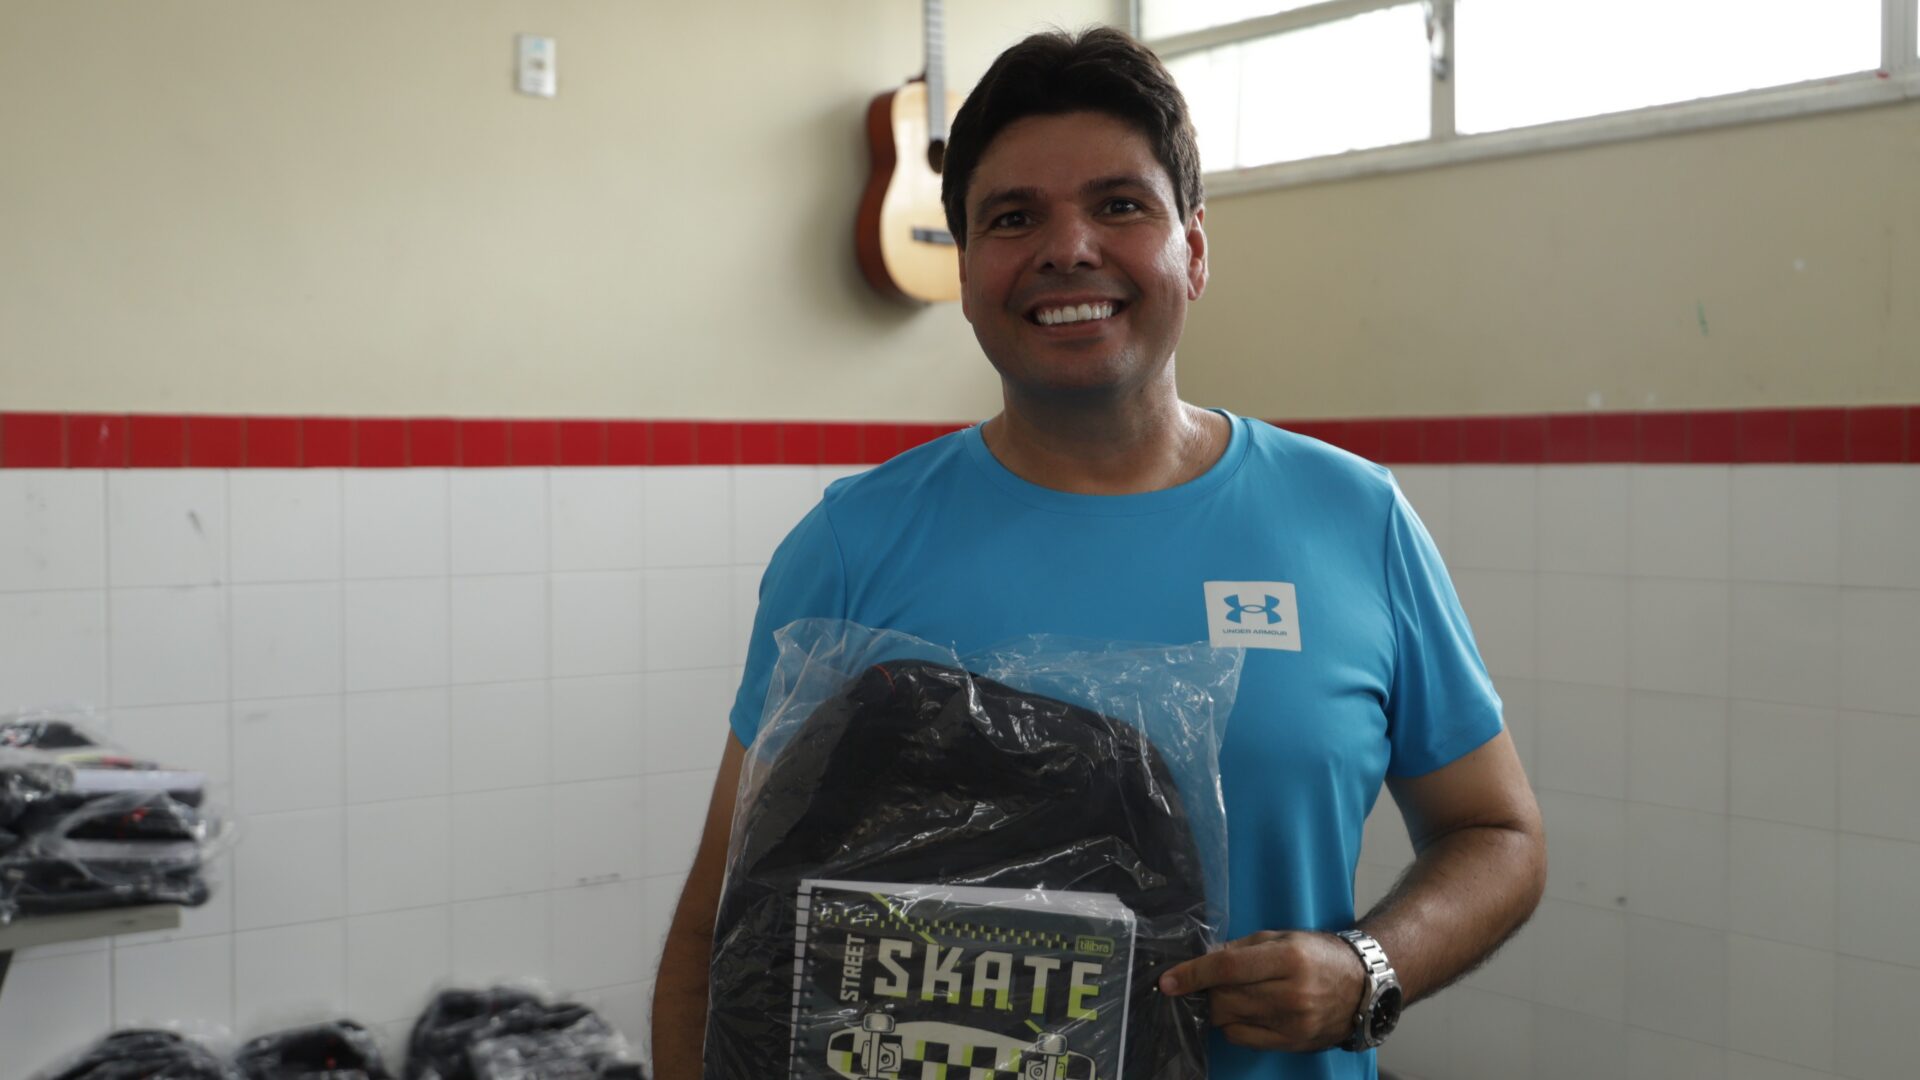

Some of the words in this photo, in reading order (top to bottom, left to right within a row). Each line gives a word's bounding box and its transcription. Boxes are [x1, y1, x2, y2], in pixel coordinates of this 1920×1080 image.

[1253, 628, 1288, 637] ARMOUR
[1080, 939, 1109, 953] tilibra
[840, 933, 865, 1002] STREET
[873, 938, 1102, 1020] SKATE
